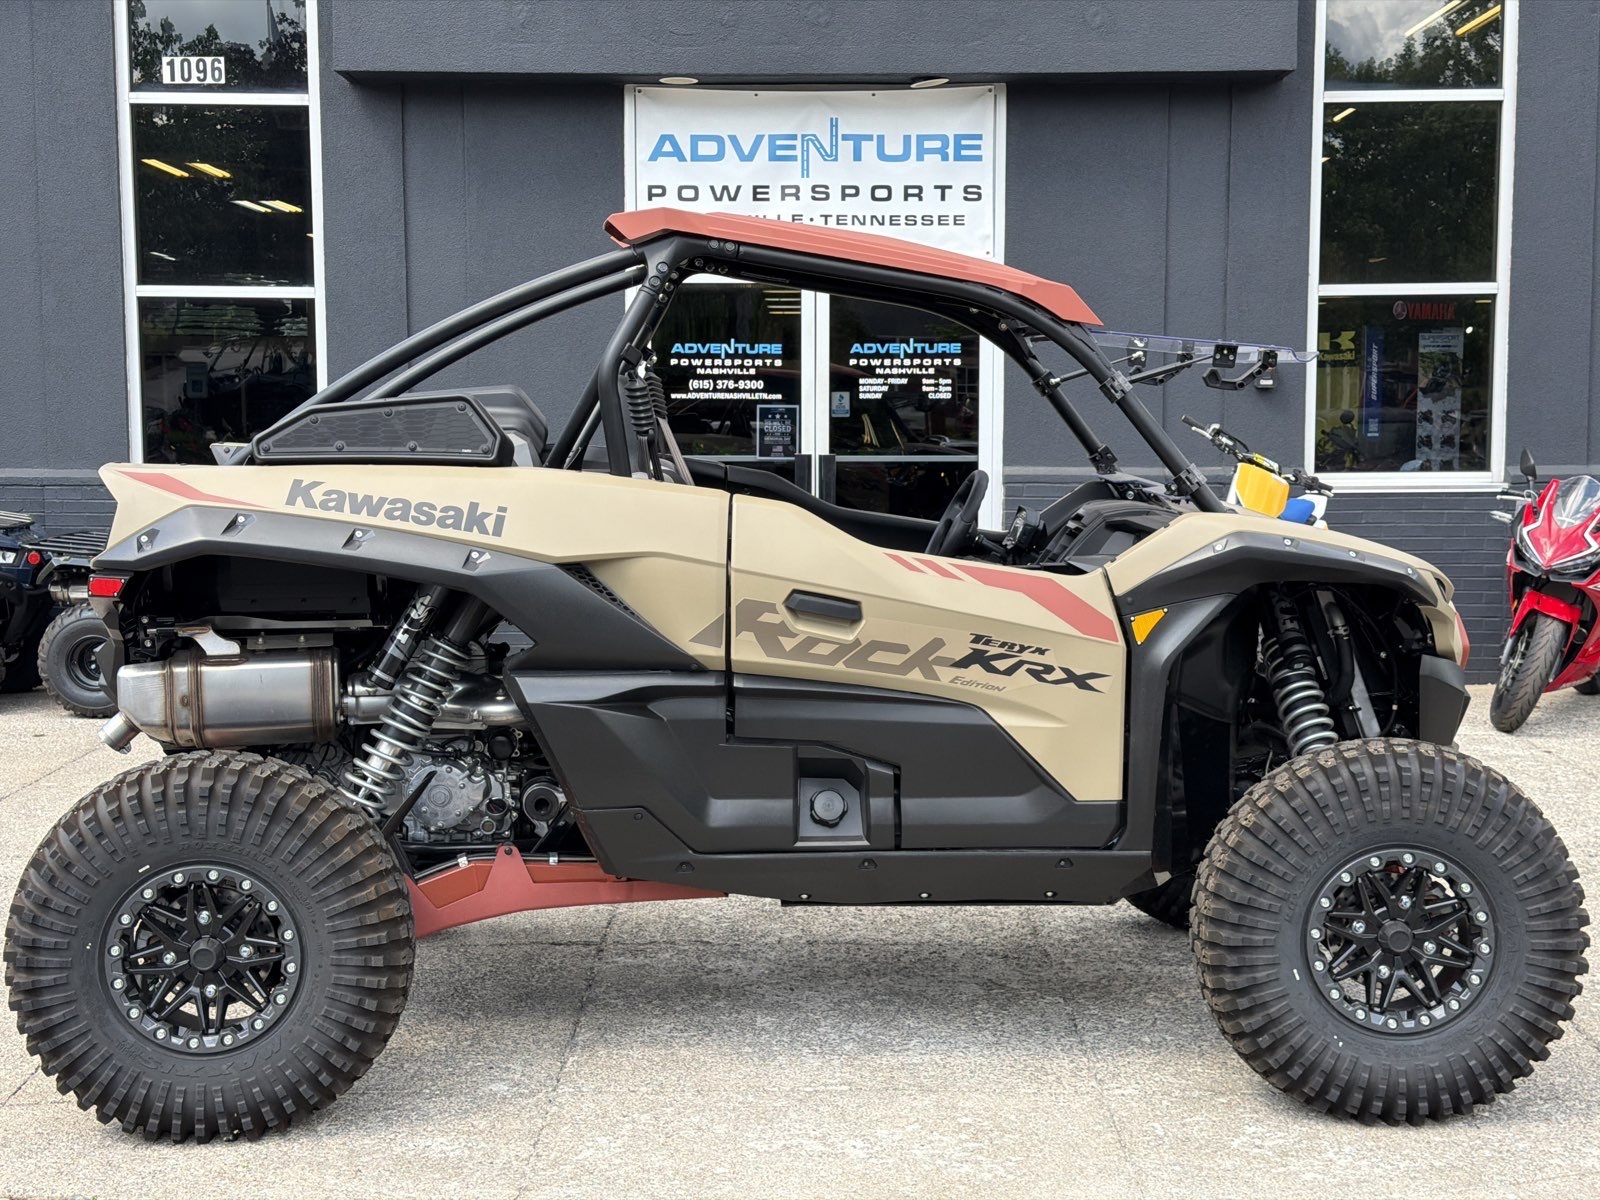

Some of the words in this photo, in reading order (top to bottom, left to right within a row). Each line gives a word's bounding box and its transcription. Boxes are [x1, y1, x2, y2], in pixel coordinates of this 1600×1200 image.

[166, 57, 223, 83] 1096
[647, 117, 983, 178] ADVENTURE
[647, 184, 983, 202] POWERSPORTS
[824, 214, 966, 227] TENNESSEE
[1408, 303, 1456, 320] YAMAHA
[670, 338, 783, 359] ADVENTURE
[850, 338, 962, 359] ADVENTURE
[670, 358, 783, 367] POWERSPORTS
[849, 358, 962, 366] POWERSPORTS
[696, 367, 756, 375] NASHVILLE
[875, 367, 935, 375] NASHVILLE
[1370, 343, 1379, 401] SUPERSPORT
[688, 379, 714, 391] (615)
[716, 379, 764, 390] 376-9300
[764, 425, 792, 433] CLOSED
[285, 478, 508, 538] Kawasaki
[949, 647, 1113, 694] KRX
